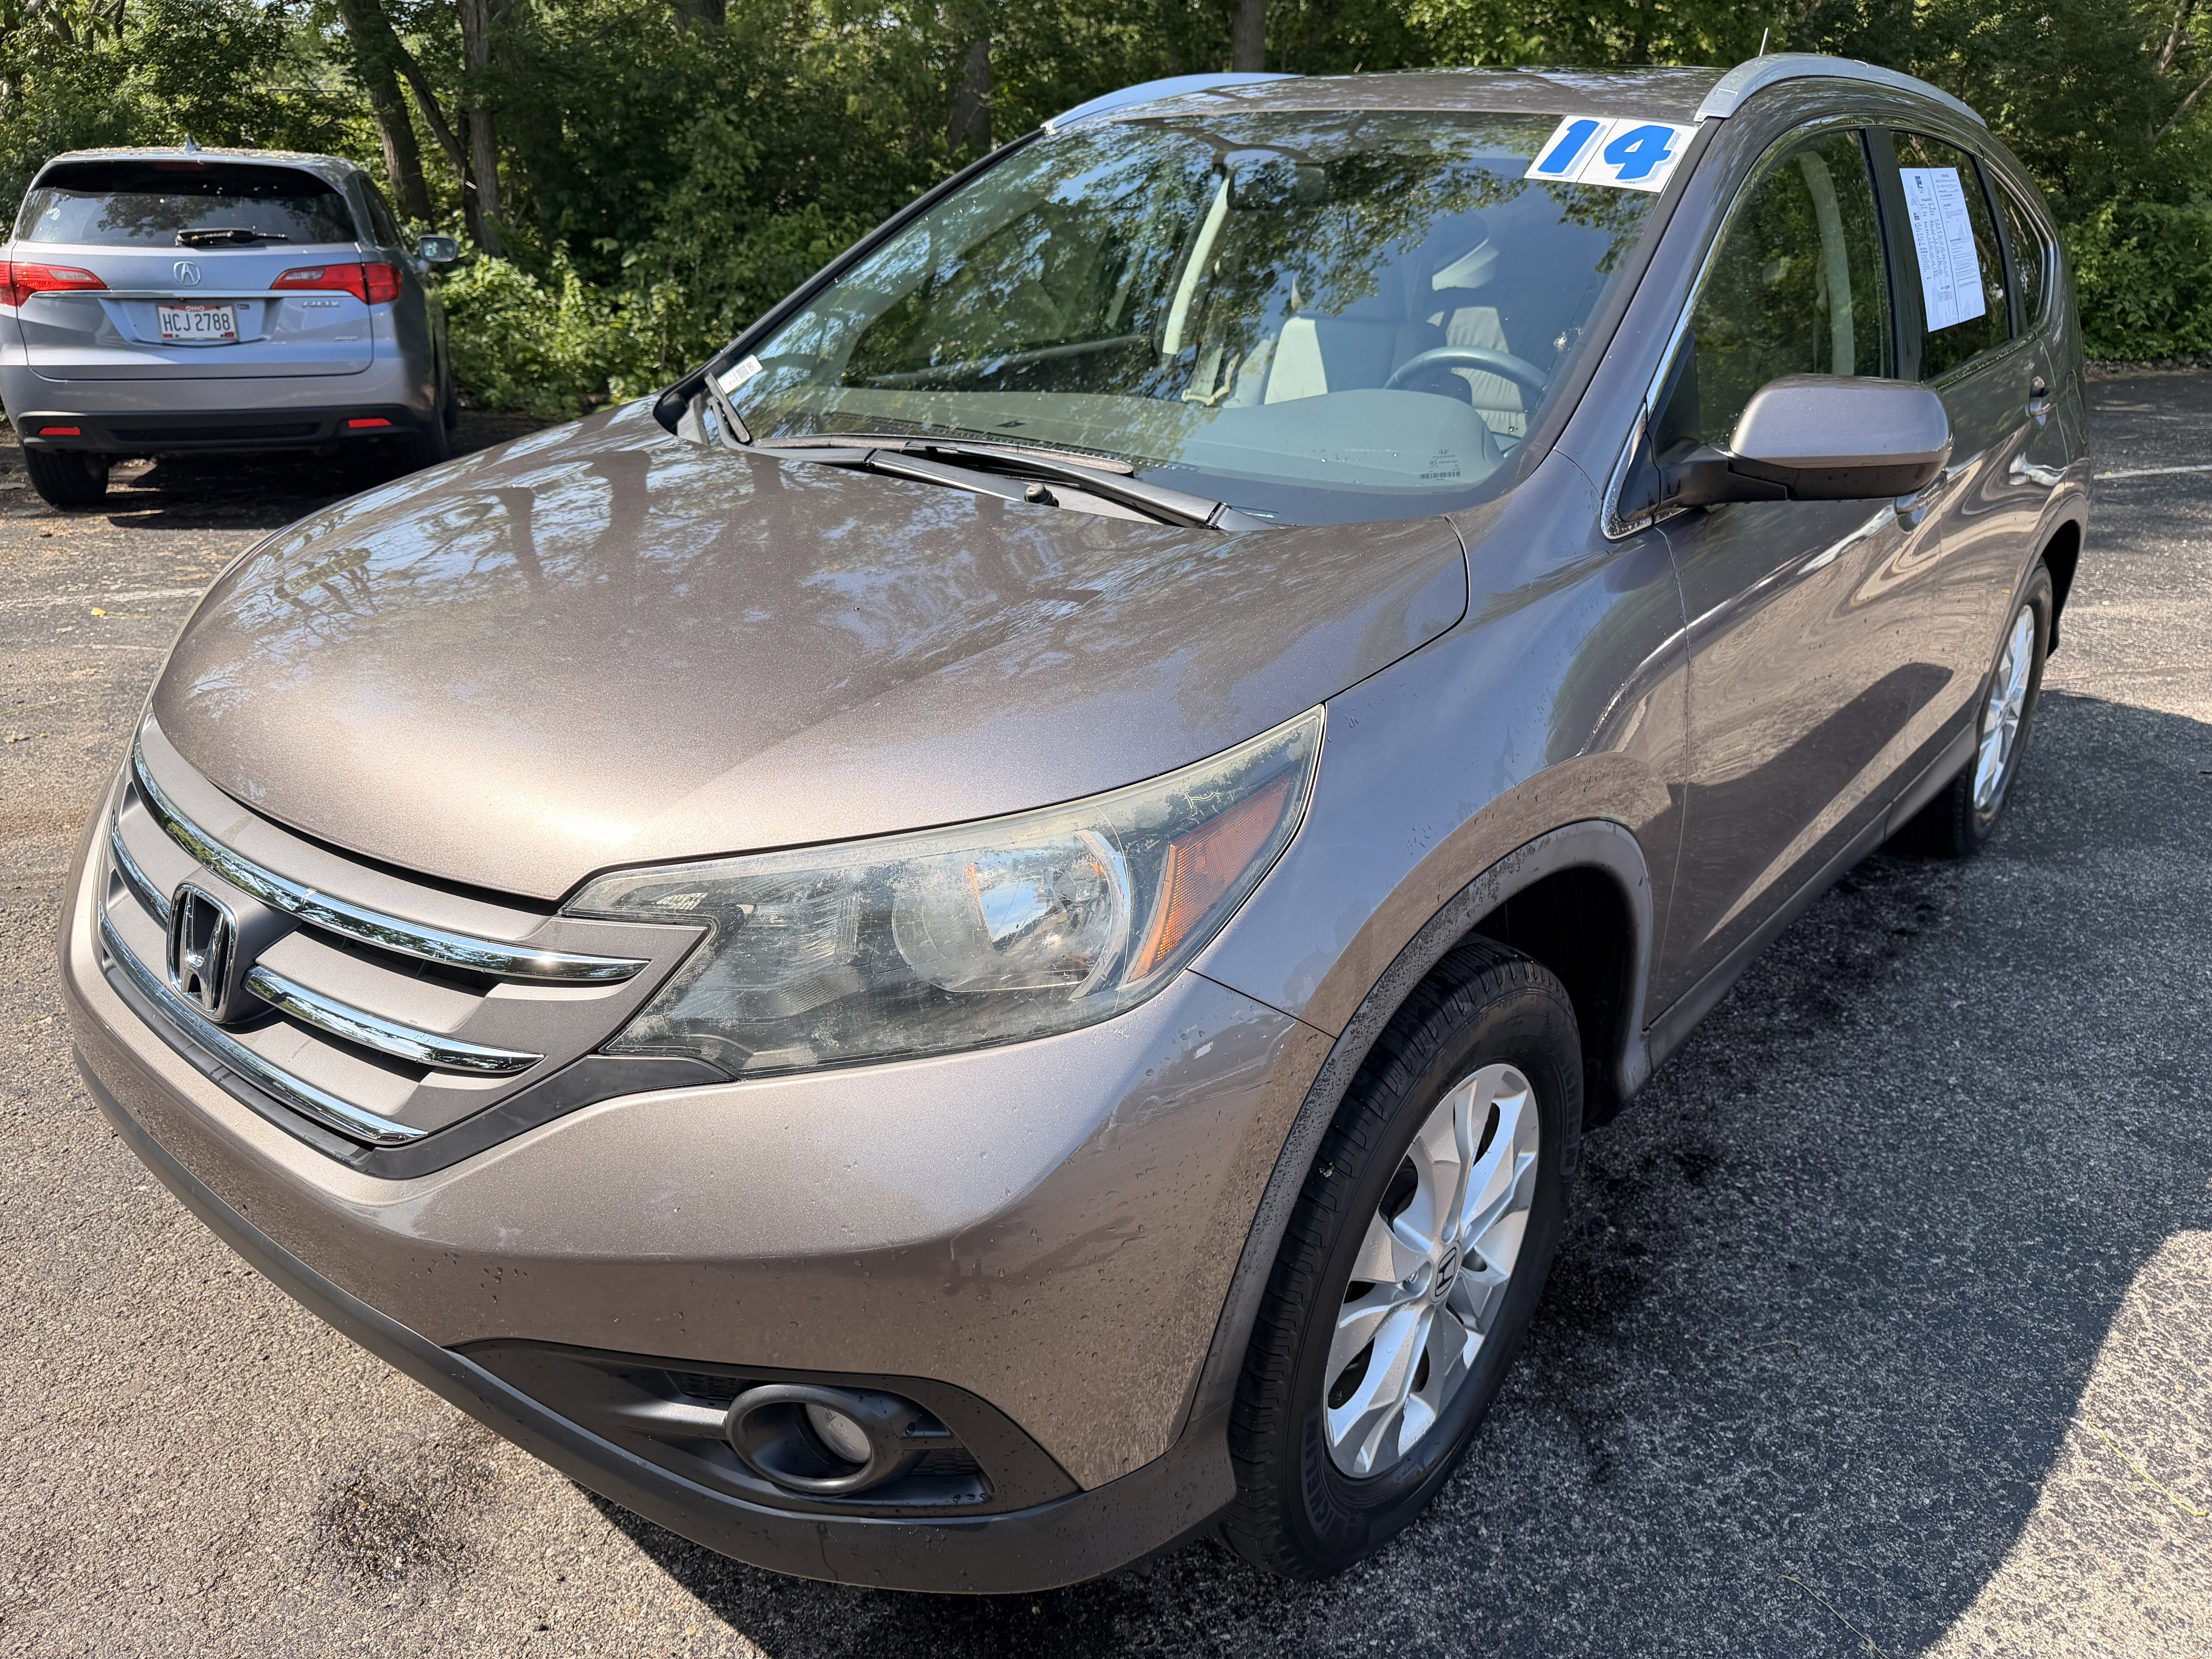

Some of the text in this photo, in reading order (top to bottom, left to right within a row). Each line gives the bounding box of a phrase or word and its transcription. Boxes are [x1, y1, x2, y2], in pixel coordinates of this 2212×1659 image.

[1537, 119, 1677, 180] 14
[163, 313, 230, 331] HCJ 2788
[1305, 1417, 1345, 1541] MICHELIN
